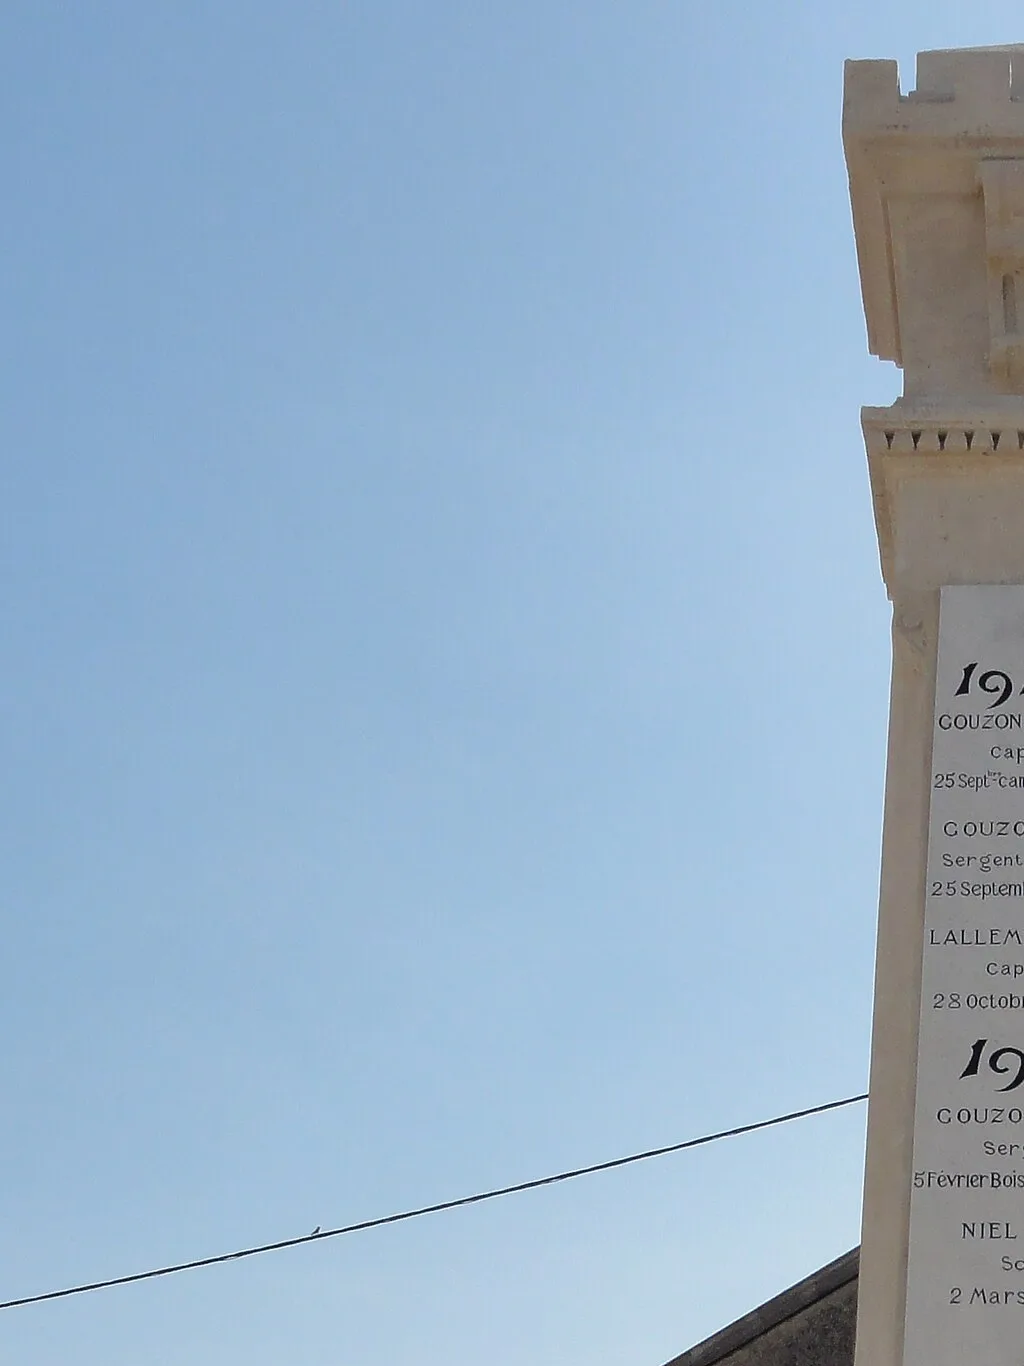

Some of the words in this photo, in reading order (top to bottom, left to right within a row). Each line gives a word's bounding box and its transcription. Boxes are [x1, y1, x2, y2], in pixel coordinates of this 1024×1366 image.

[938, 713, 1022, 730] GOUZON
[934, 773, 955, 789] 25
[942, 853, 1023, 872] Sergent
[931, 881, 956, 897] 25
[933, 993, 961, 1010] 28
[913, 1171, 926, 1188] 5
[961, 1222, 1018, 1239] NIEL
[949, 1287, 962, 1304] 2
